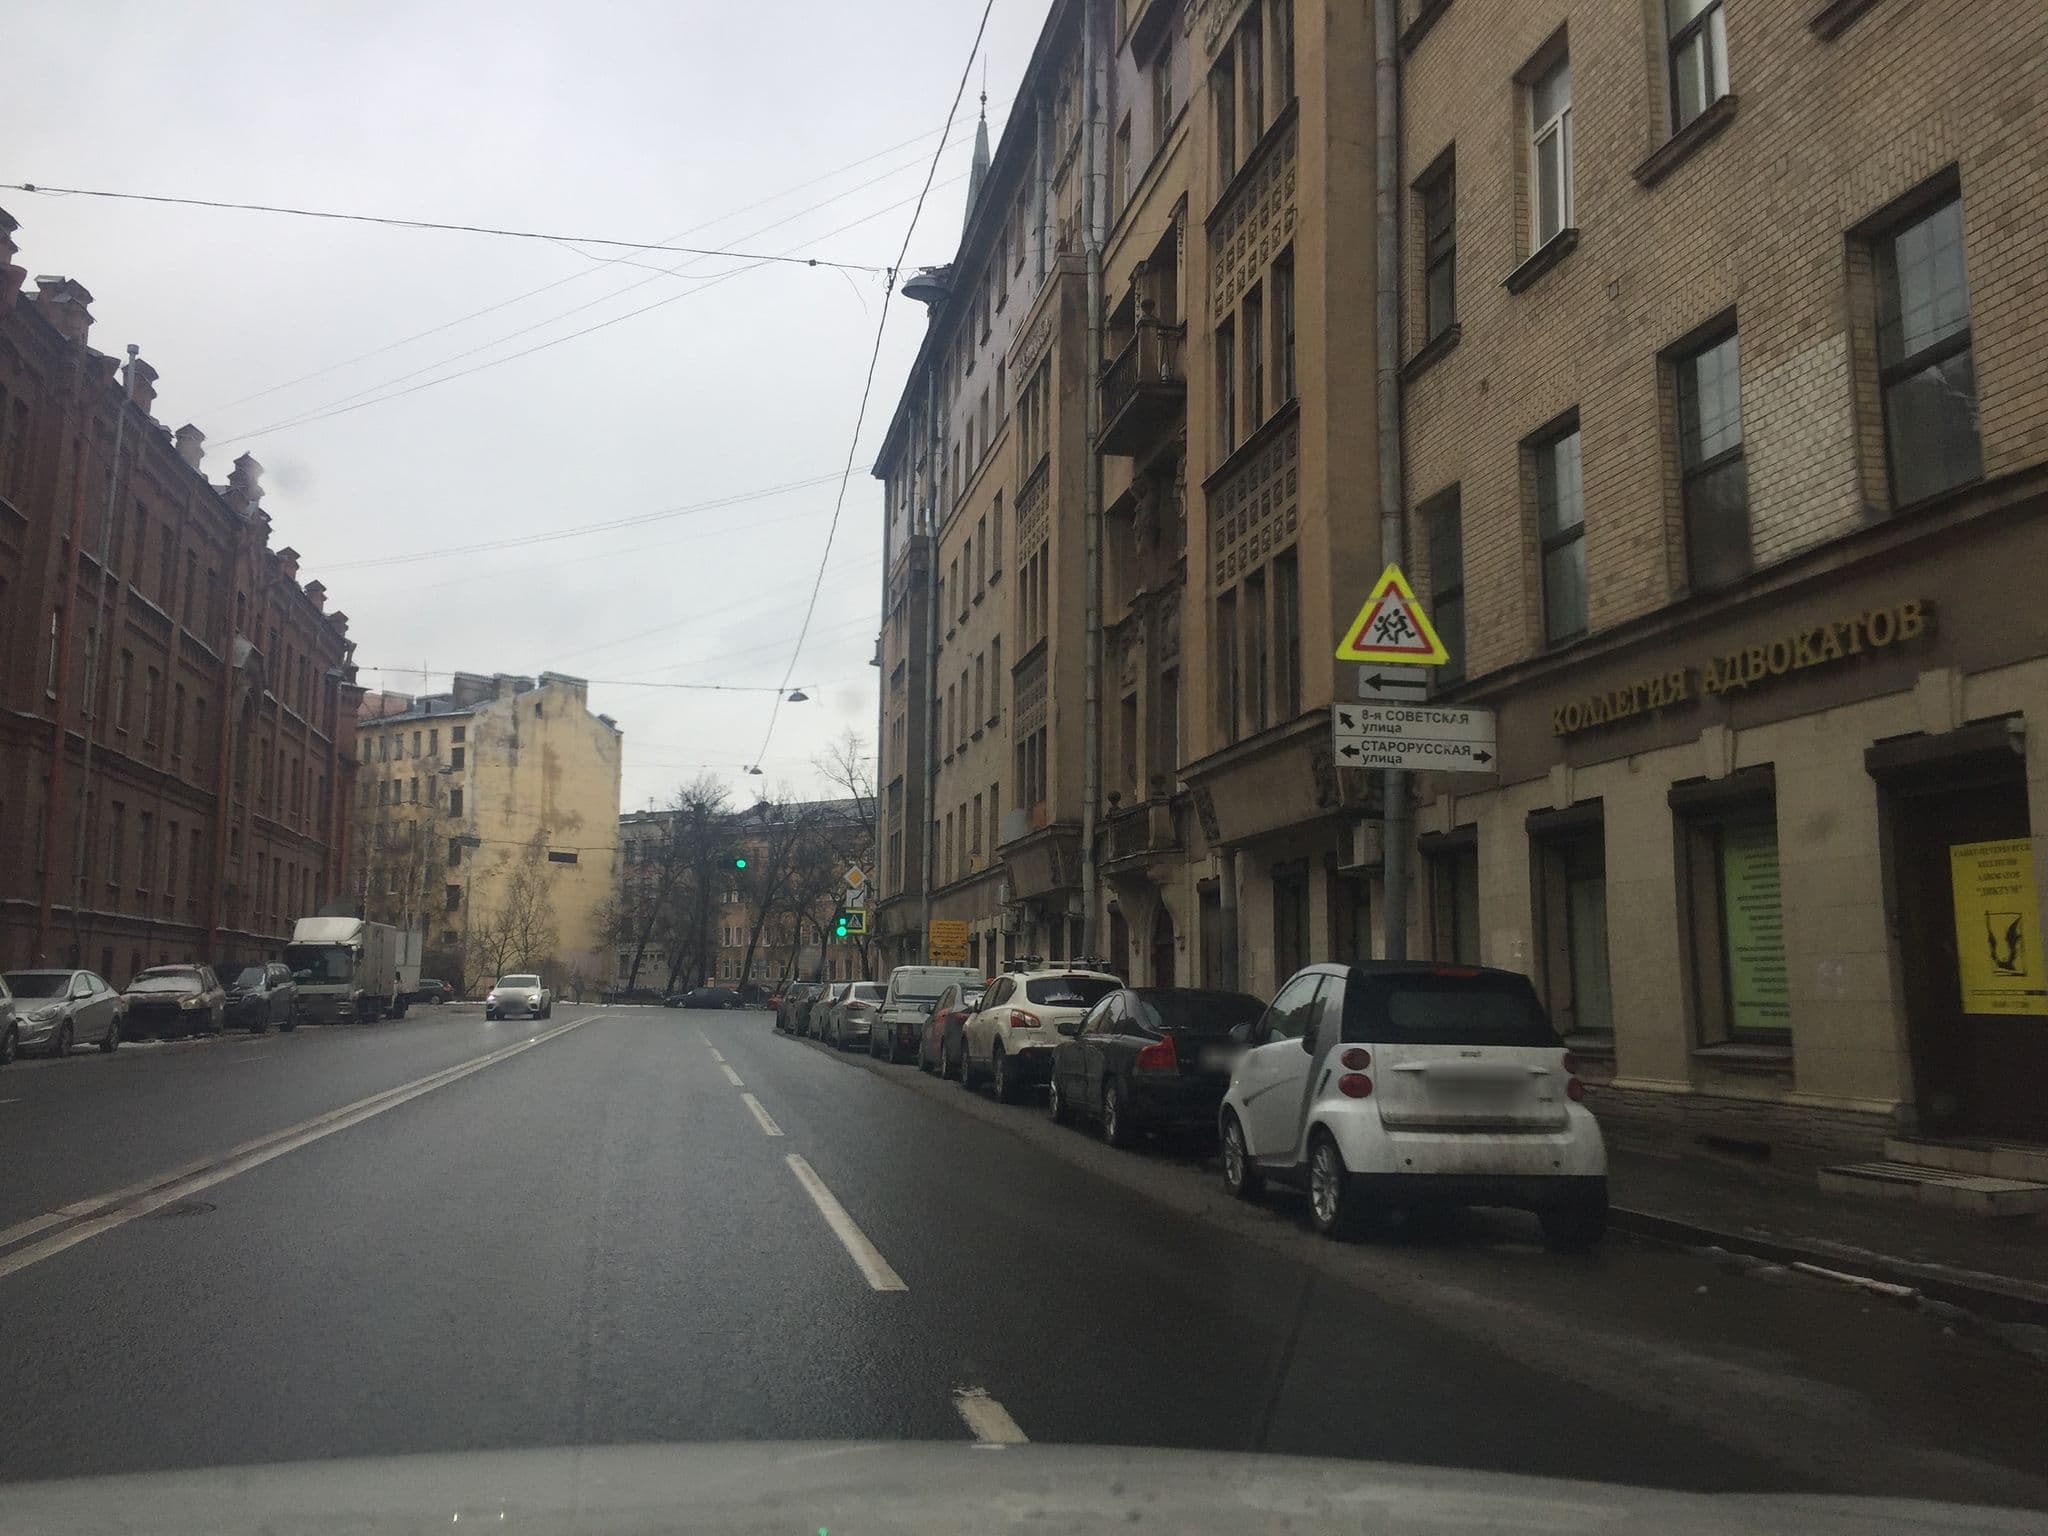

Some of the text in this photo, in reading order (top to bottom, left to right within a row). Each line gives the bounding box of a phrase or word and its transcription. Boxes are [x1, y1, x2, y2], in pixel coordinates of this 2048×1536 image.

[1551, 599, 1925, 736] КОЛЛЕГИЯ АДВОКАТОВ
[1362, 709, 1469, 725] 8-я СОВЕТСКАЯ
[1362, 723, 1402, 734] улица
[1361, 740, 1471, 756] СТАРОРУССКАЯ
[1362, 754, 1402, 766] улица
